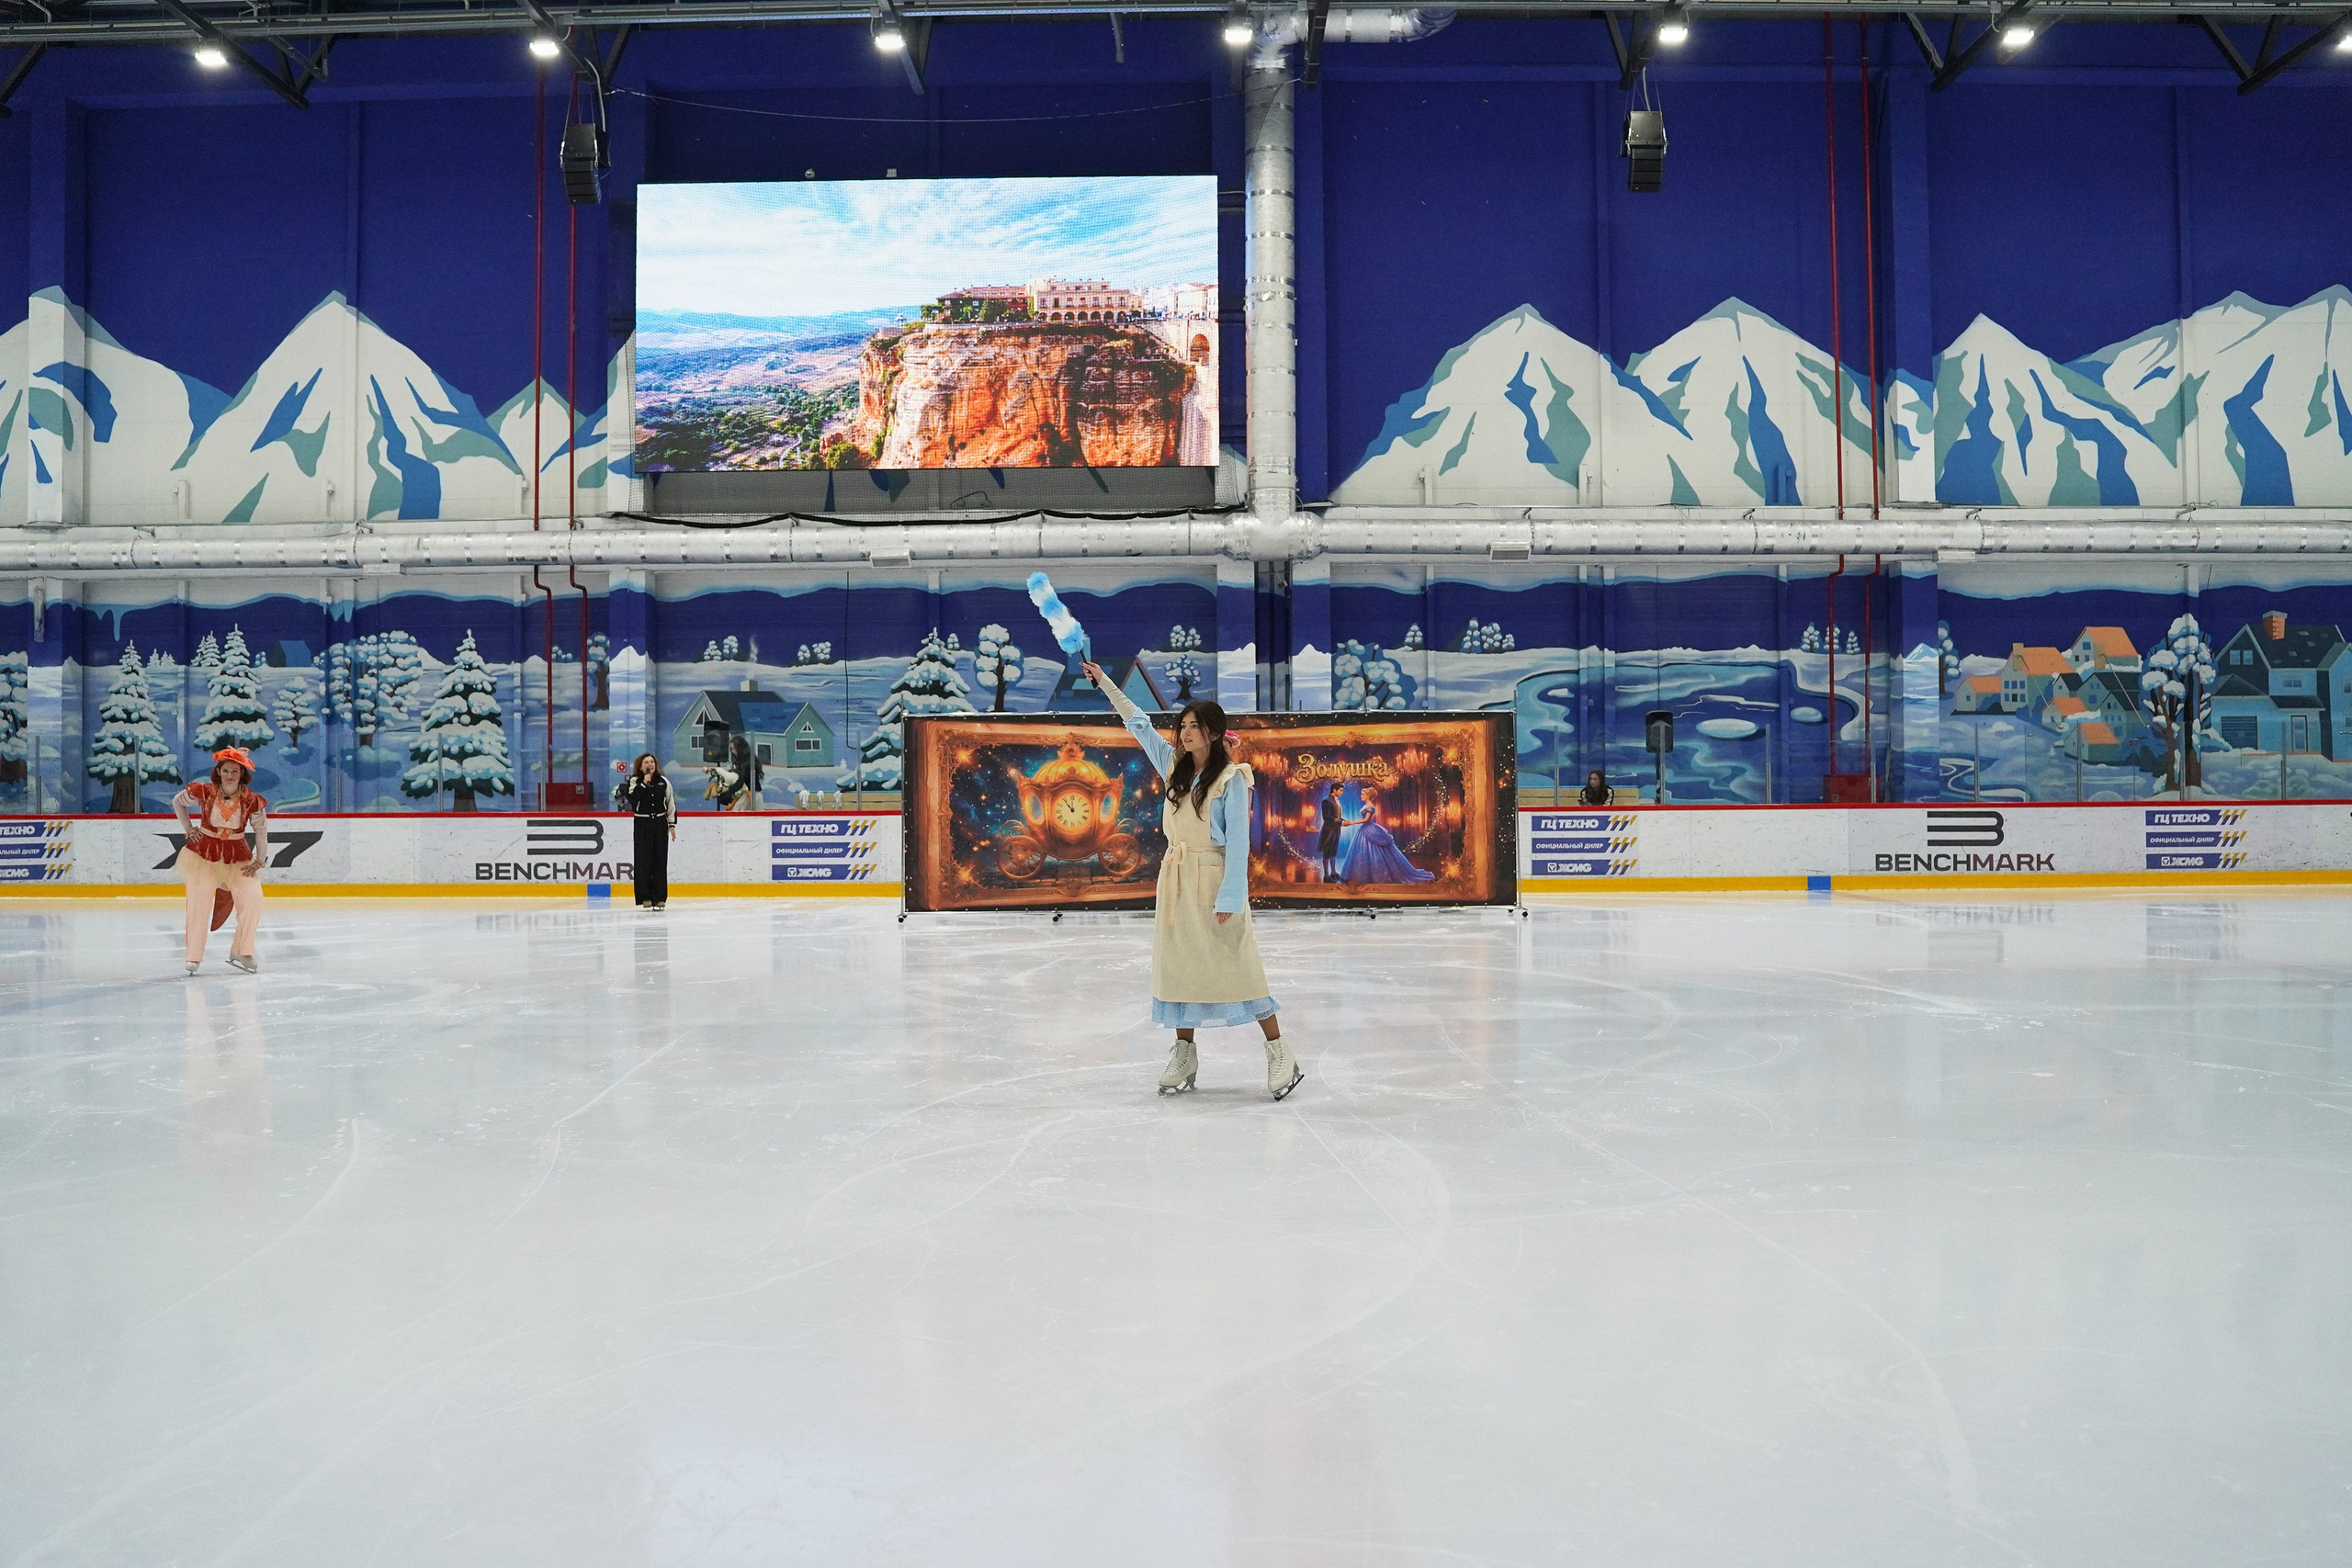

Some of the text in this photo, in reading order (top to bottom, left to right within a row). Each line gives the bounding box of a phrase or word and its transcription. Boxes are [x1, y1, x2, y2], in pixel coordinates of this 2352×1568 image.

[1296, 753, 1394, 783] Золушка
[1541, 818, 1600, 830] ГЦ ТЕХНО
[2154, 813, 2211, 824] ГЦ ТЕХНО
[780, 823, 839, 835] ГЦ ТЕХНО
[2150, 836, 2195, 844] ОФИЦИАЛЬНЫЙ
[1875, 853, 2055, 872] BENCHMARK
[2170, 856, 2204, 866] XCMG
[475, 862, 635, 881] BENCHMAR
[797, 867, 832, 877] XCMG
[1556, 863, 1592, 873] XCMG
